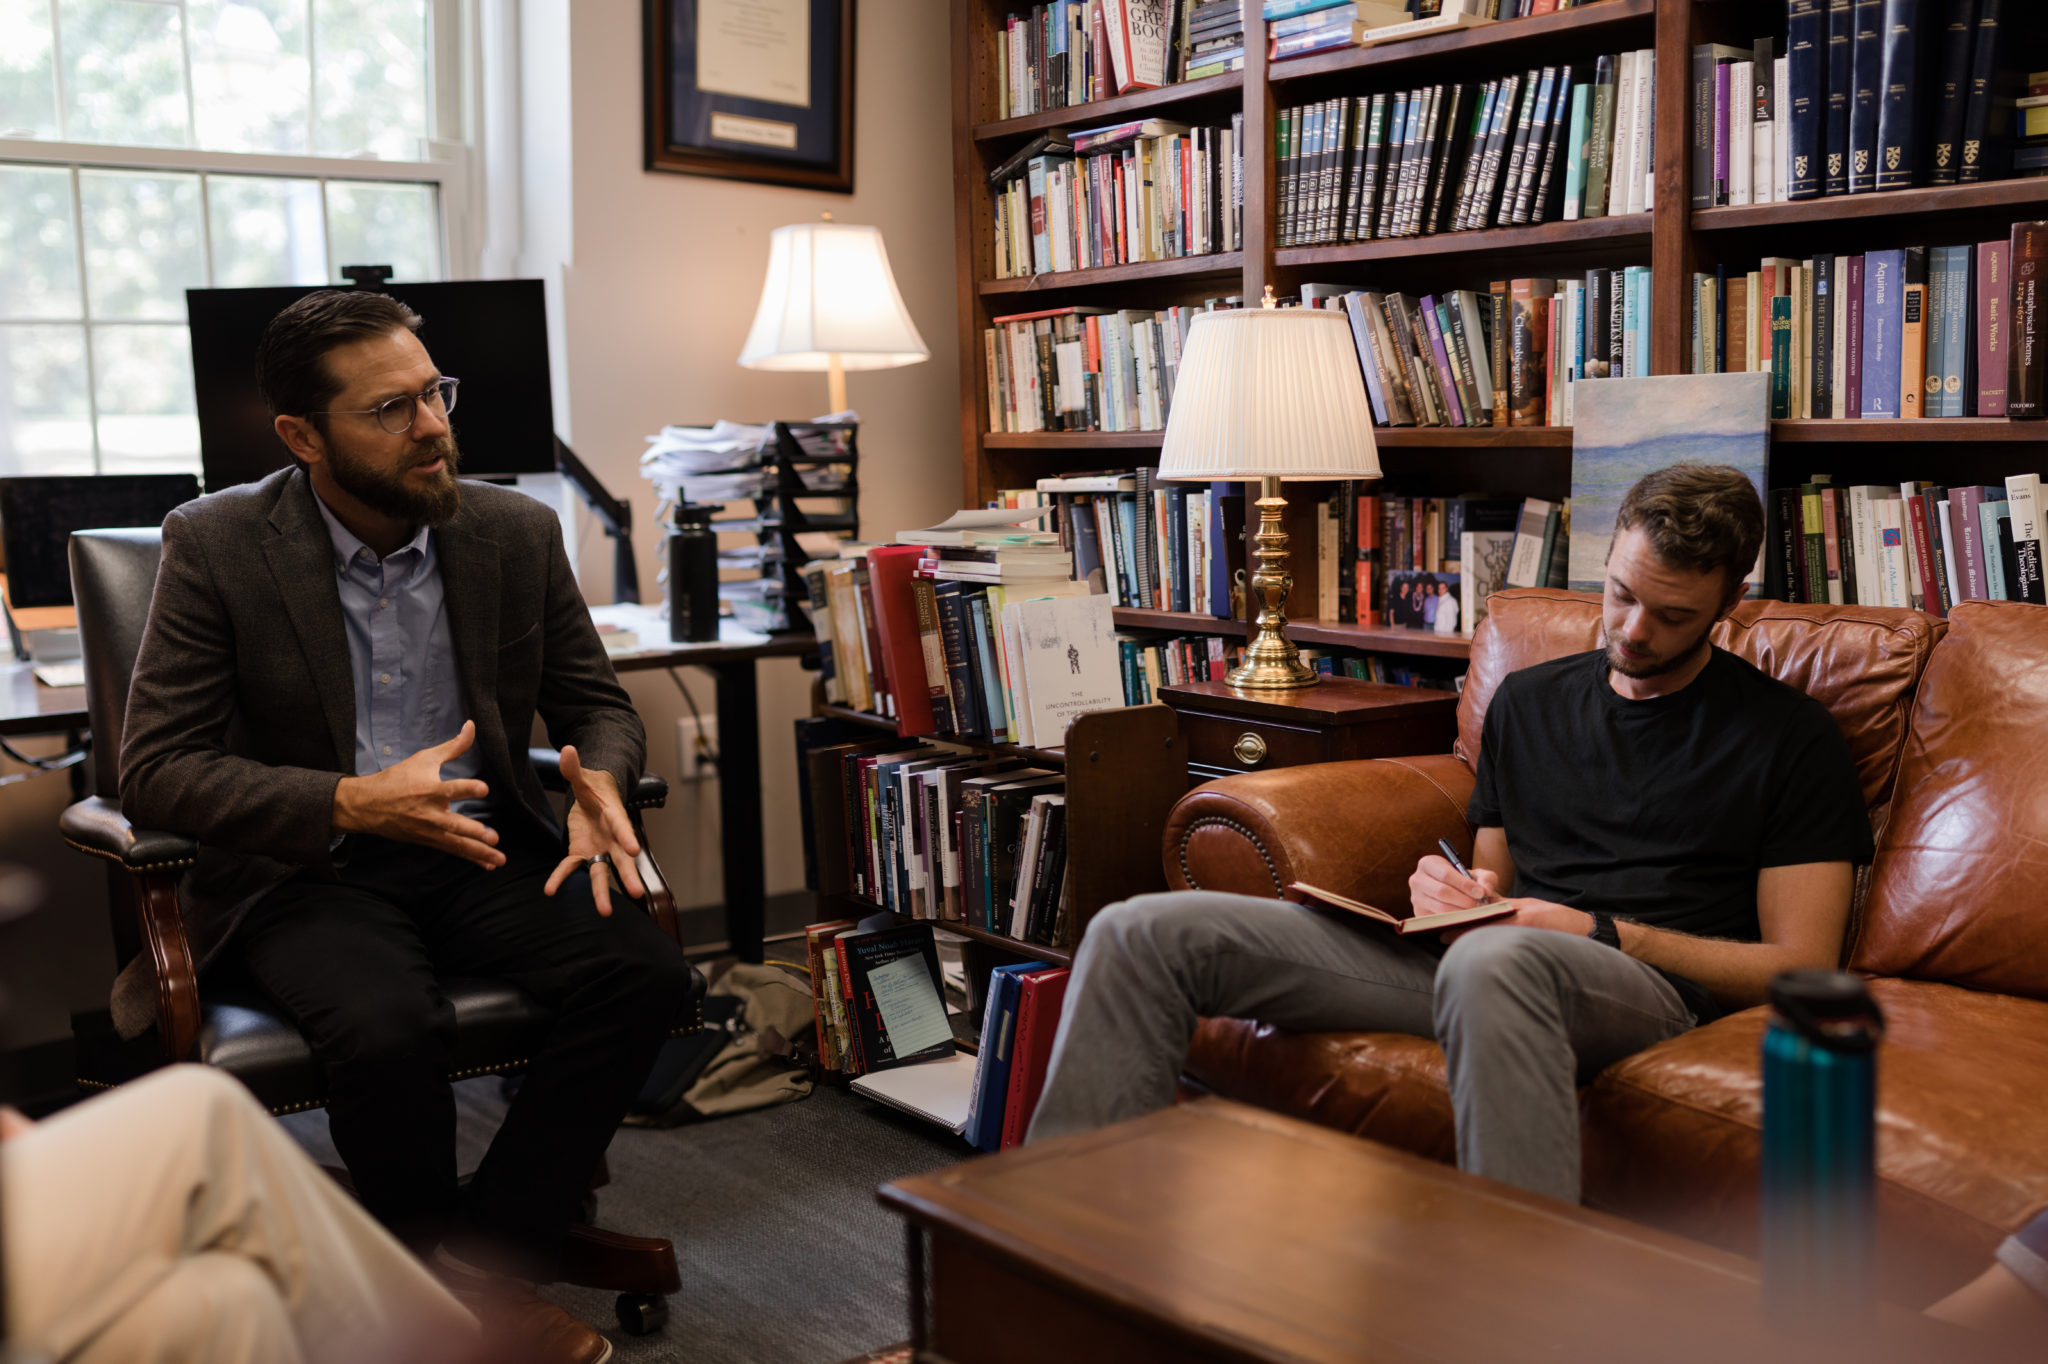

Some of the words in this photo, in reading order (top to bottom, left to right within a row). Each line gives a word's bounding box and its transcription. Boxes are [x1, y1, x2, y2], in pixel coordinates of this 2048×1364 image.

[1130, 7, 1164, 27] GRE
[1132, 22, 1165, 41] BOO
[1619, 78, 1631, 130] Philosophical
[1636, 77, 1648, 129] Philosophical
[1757, 85, 1765, 97] On
[1756, 99, 1768, 118] Evil
[1590, 94, 1603, 168] CONVERSATION
[1597, 137, 1606, 168] GREAT
[1616, 133, 1627, 159] Papers
[1634, 132, 1644, 158] Papers
[1091, 163, 1099, 187] EMILE
[1990, 251, 1998, 283] AQUINAS
[1611, 274, 1624, 301] WHEN
[1875, 262, 1888, 304] Aquinas
[1493, 295, 1503, 319] Jesus
[1818, 297, 1826, 313] THE
[1990, 297, 1998, 321] Basic
[2026, 280, 2037, 334] metaphysical
[1452, 320, 1461, 334] The
[1610, 302, 1623, 340] SKEPTICS
[1817, 316, 1826, 344] ETHICS
[1456, 336, 1467, 358] Jesus
[1610, 341, 1623, 357] ASK
[1989, 323, 1998, 352] Works
[1369, 331, 1378, 344] The
[1377, 370, 1387, 384] God
[1494, 339, 1503, 388] Eyewitnesses
[1512, 315, 1525, 398] Christobiography
[1817, 346, 1825, 356] OF
[1875, 343, 1883, 361] Stump
[2025, 336, 2035, 366] themes
[1461, 359, 1474, 385] Legend
[1816, 359, 1825, 397] AQUINAS
[1855, 492, 1863, 518] Medieval
[2010, 493, 2032, 501] Evans
[1784, 529, 1792, 543] The
[1883, 528, 1901, 546] The
[1984, 509, 1994, 540] AQUINAS
[2024, 520, 2033, 539] The
[1856, 521, 1865, 556] Philosophy
[1917, 530, 1925, 546] PHYSICS
[1114, 532, 1125, 575] CONVICTION
[1785, 544, 1793, 560] One
[1885, 546, 1895, 561] Spirit
[1963, 526, 1973, 558] Readings
[1968, 568, 1978, 598] Medieval
[2026, 541, 2039, 581] Medieval
[1786, 561, 1794, 575] and
[1936, 549, 1947, 586] Recovering
[2017, 547, 2030, 598] Theologians
[1787, 577, 1795, 589] the
[916, 587, 926, 626] DOGMATICS
[920, 586, 931, 625] REFORMED
[1941, 587, 1950, 611] Nature
[1045, 697, 1111, 710] UNCONTROLLABILITY
[881, 804, 889, 830] BAPTIST
[1042, 808, 1052, 839] Knowledge,
[1035, 872, 1043, 889] Value
[857, 945, 877, 955] Yuval
[878, 942, 899, 951] Noah
[839, 946, 849, 972] Homo
[844, 973, 852, 993] Deus
[883, 1045, 892, 1055] of
